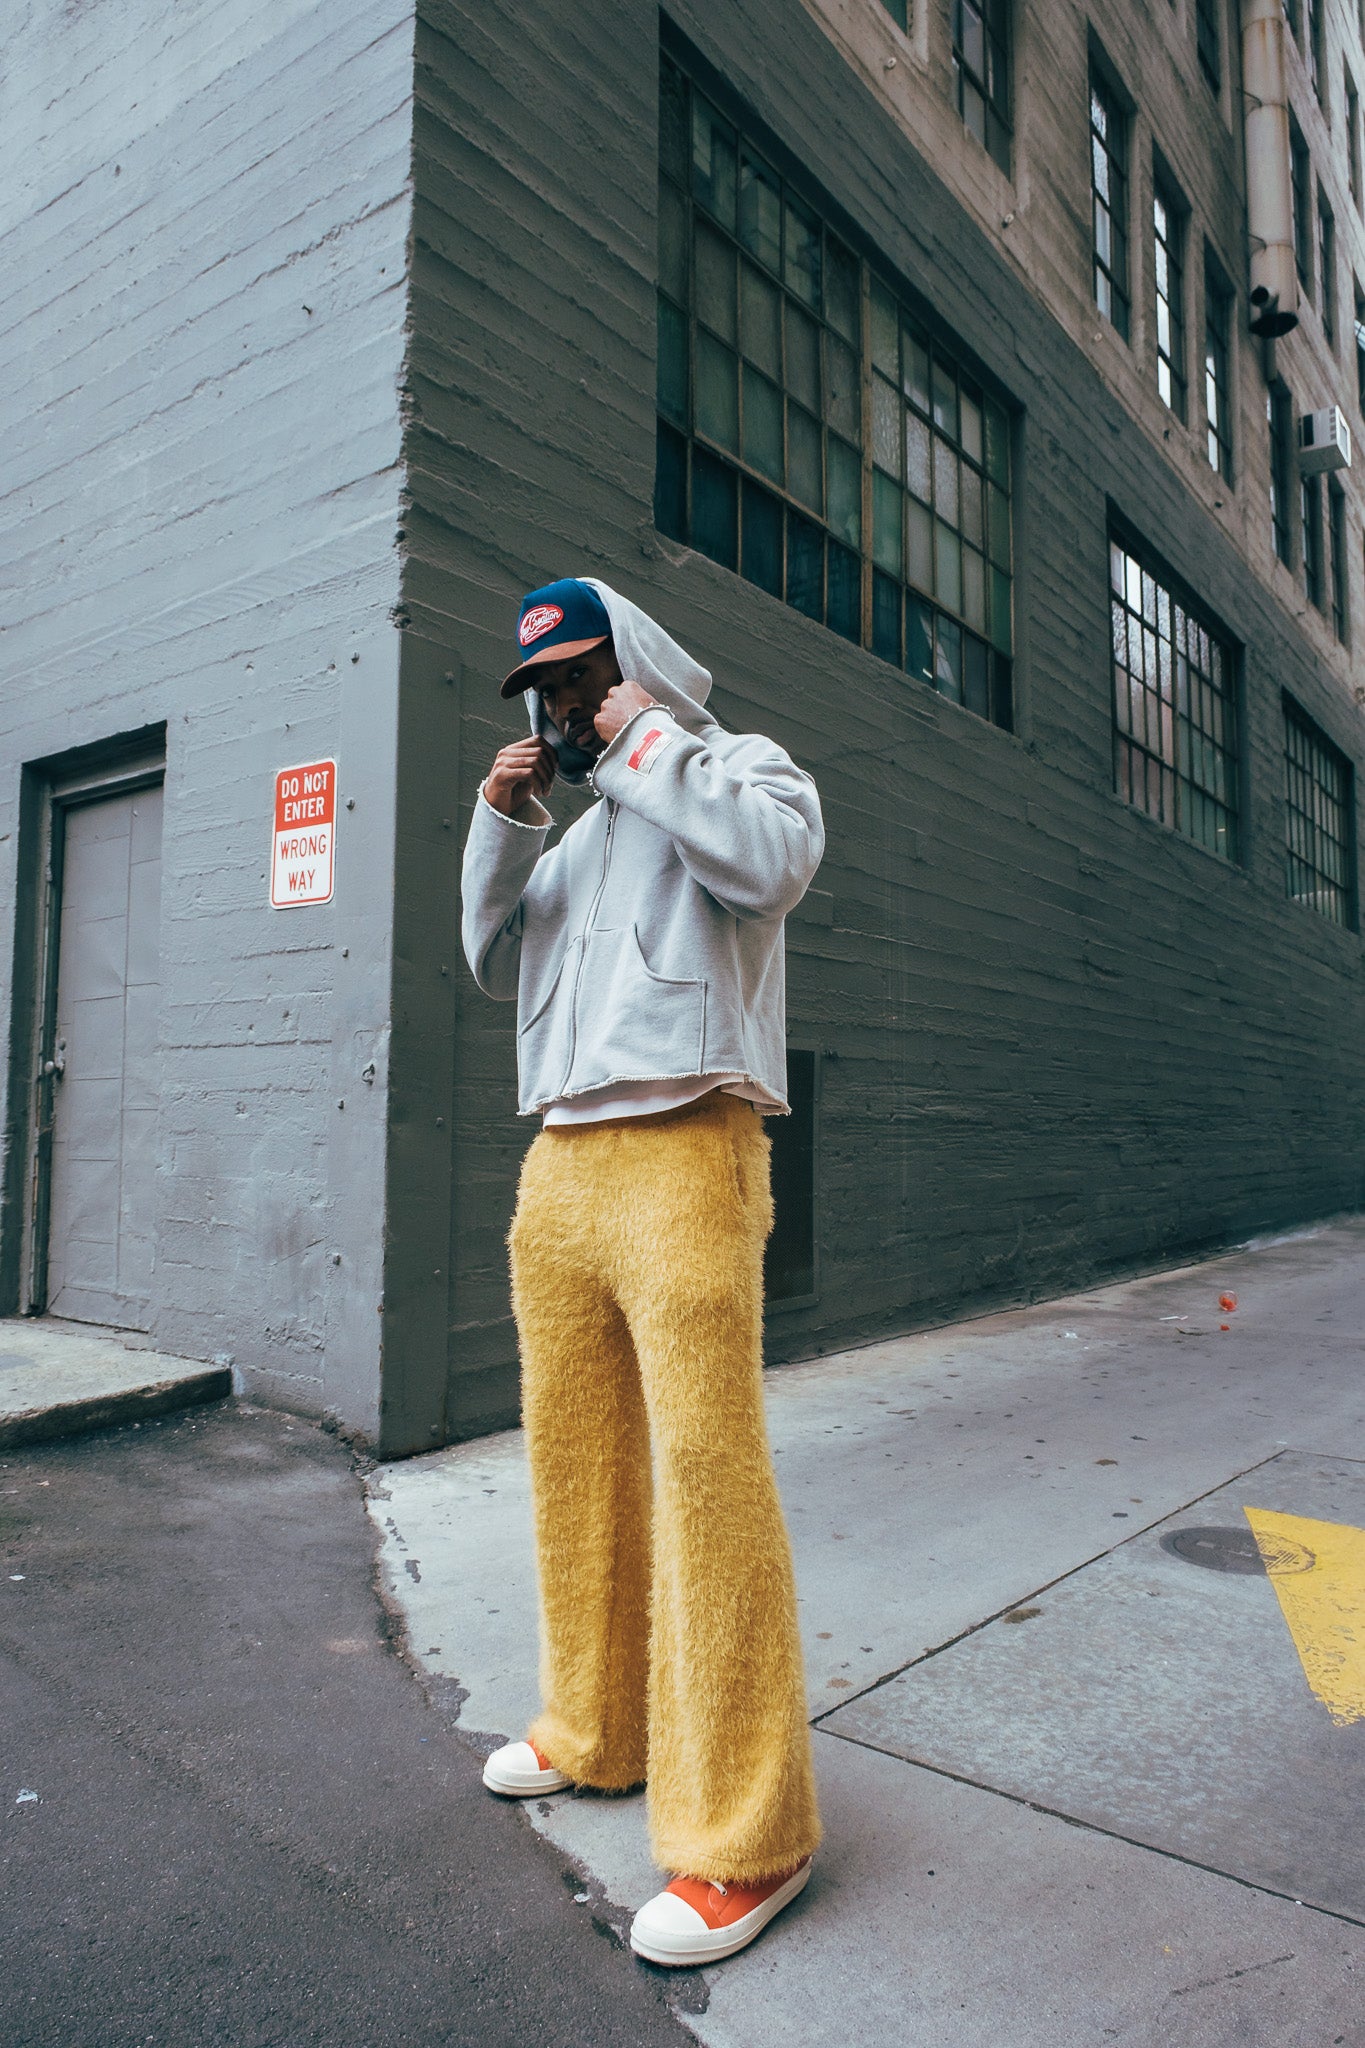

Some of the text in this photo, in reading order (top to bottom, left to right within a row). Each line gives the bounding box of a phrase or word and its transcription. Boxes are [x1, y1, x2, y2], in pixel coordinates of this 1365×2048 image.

[281, 770, 330, 799] DO NOT
[284, 796, 325, 822] ENTER
[280, 834, 327, 860] WRONG
[288, 869, 316, 892] WAY
